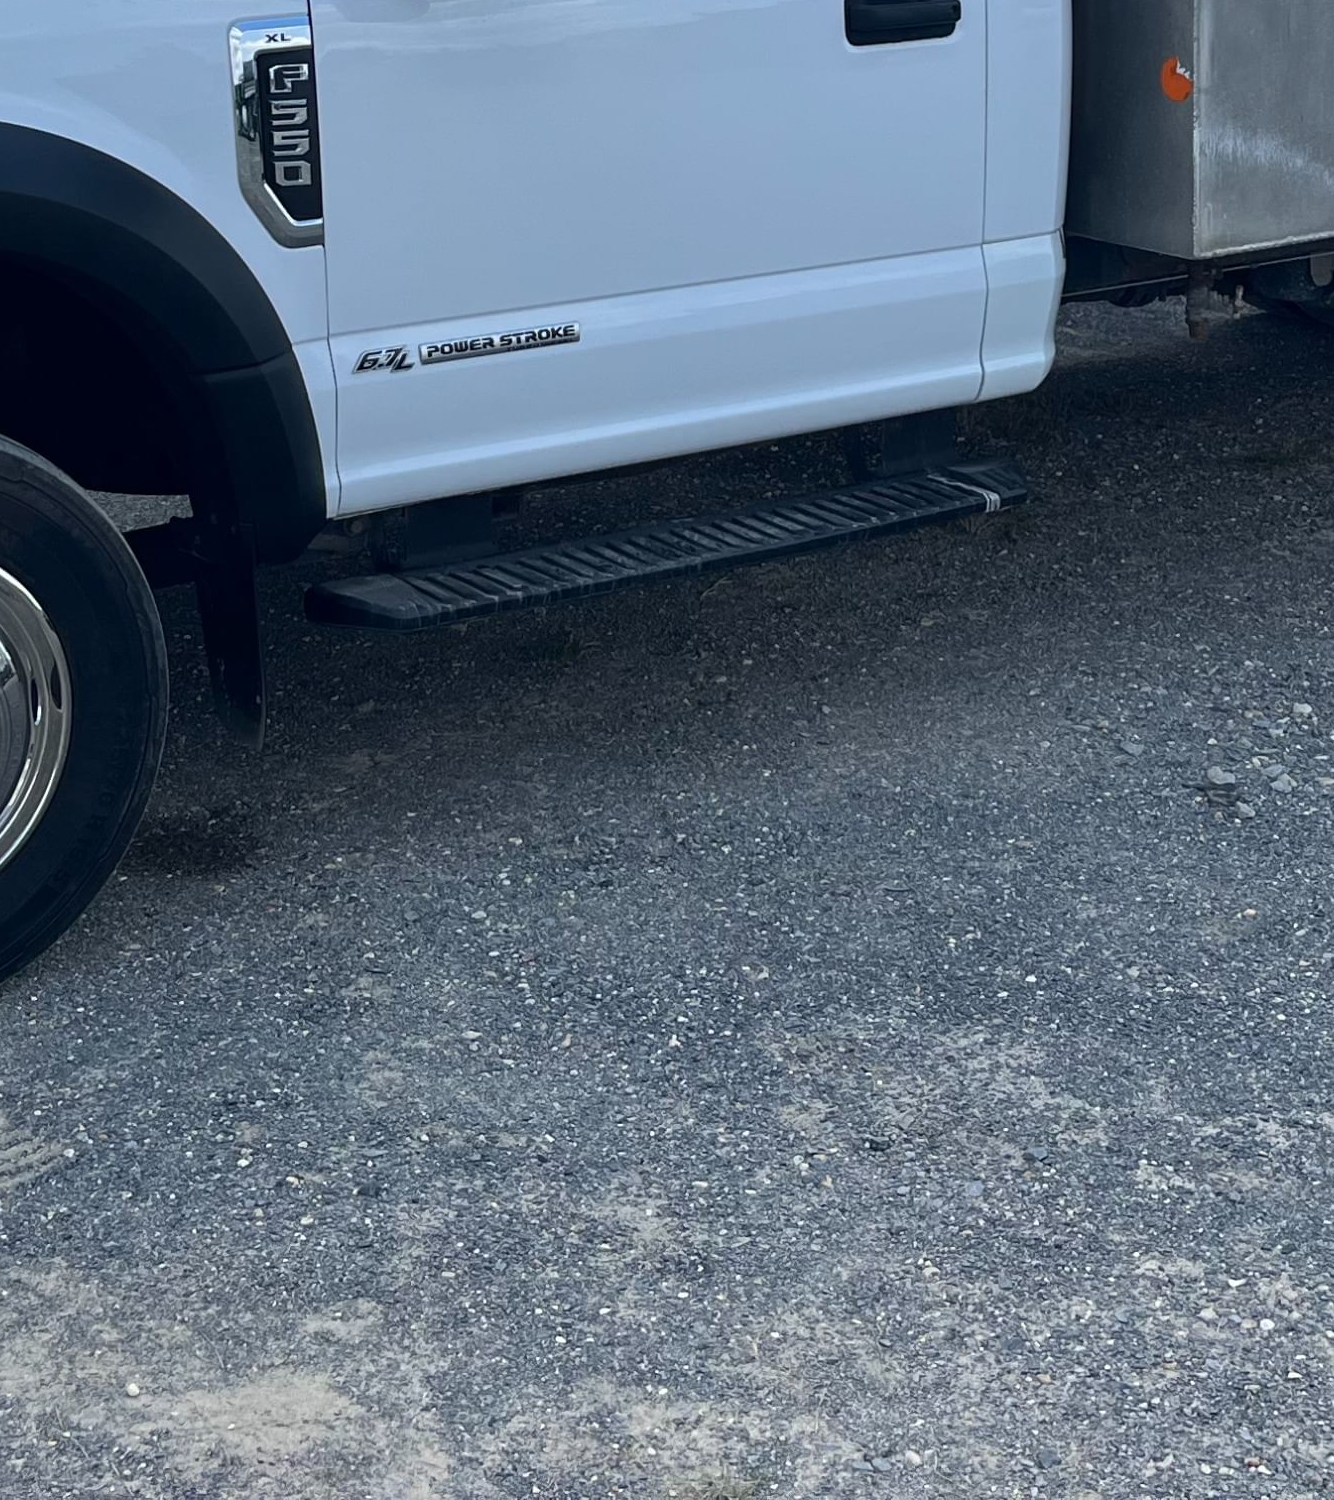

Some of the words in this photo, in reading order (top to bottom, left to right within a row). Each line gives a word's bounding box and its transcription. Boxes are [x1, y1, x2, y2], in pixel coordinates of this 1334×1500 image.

[265, 32, 291, 43] XL
[269, 63, 312, 187] F550
[425, 337, 495, 358] POWER
[499, 324, 577, 347] STROKE
